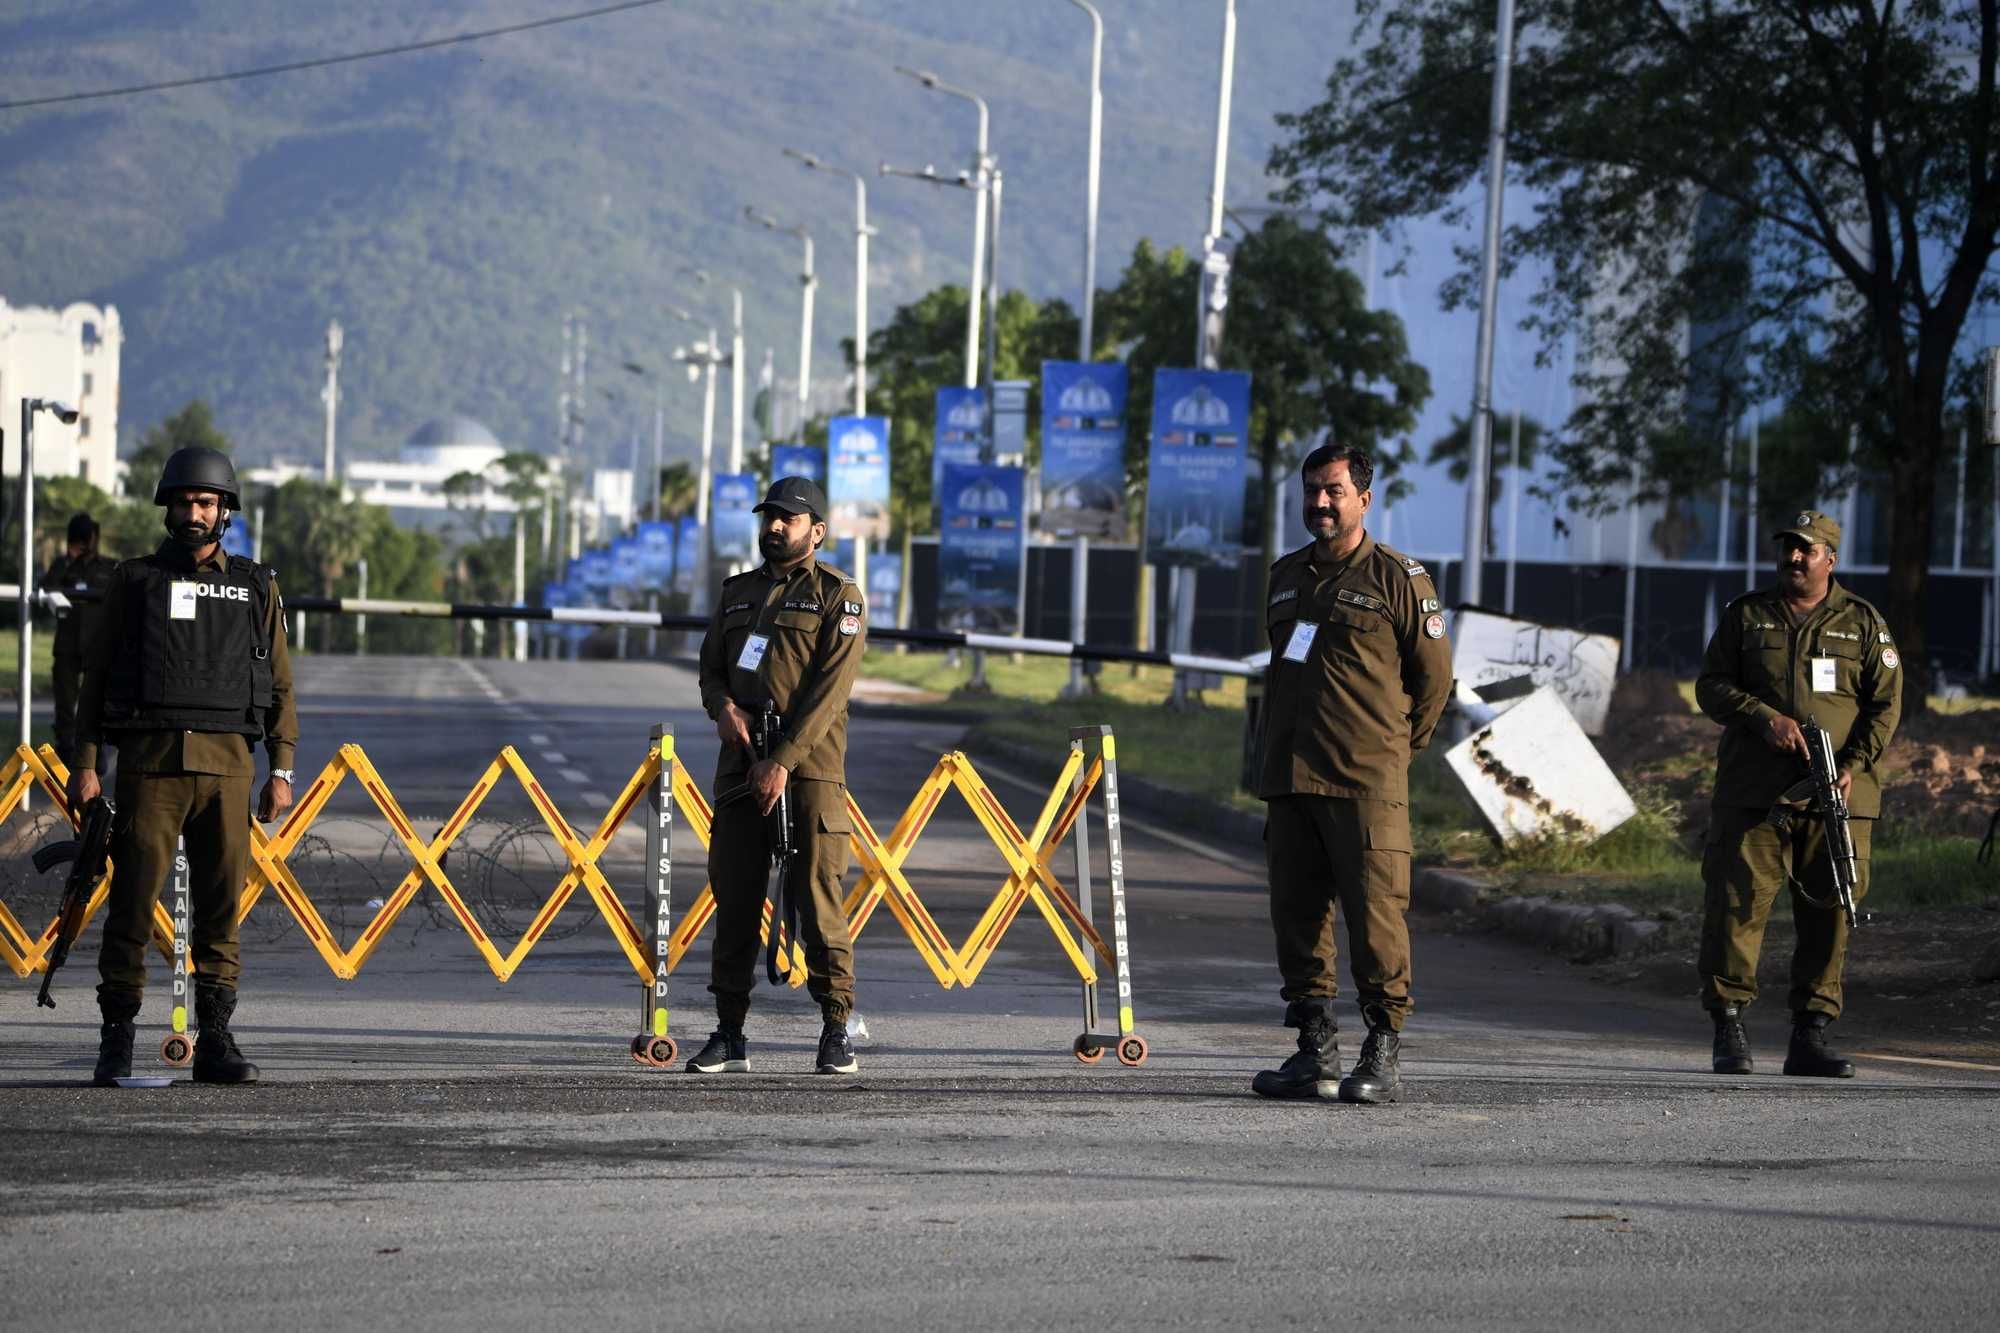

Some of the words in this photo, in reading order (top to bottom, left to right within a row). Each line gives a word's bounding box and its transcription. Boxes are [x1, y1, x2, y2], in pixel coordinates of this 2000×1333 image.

[197, 583, 249, 601] OLICE
[659, 771, 672, 828] ITP
[1106, 772, 1120, 830] ITP
[173, 834, 187, 996] ISLAMBAD
[656, 838, 671, 997] ISLAMBAD
[1112, 840, 1131, 998] ISLAMBAD
